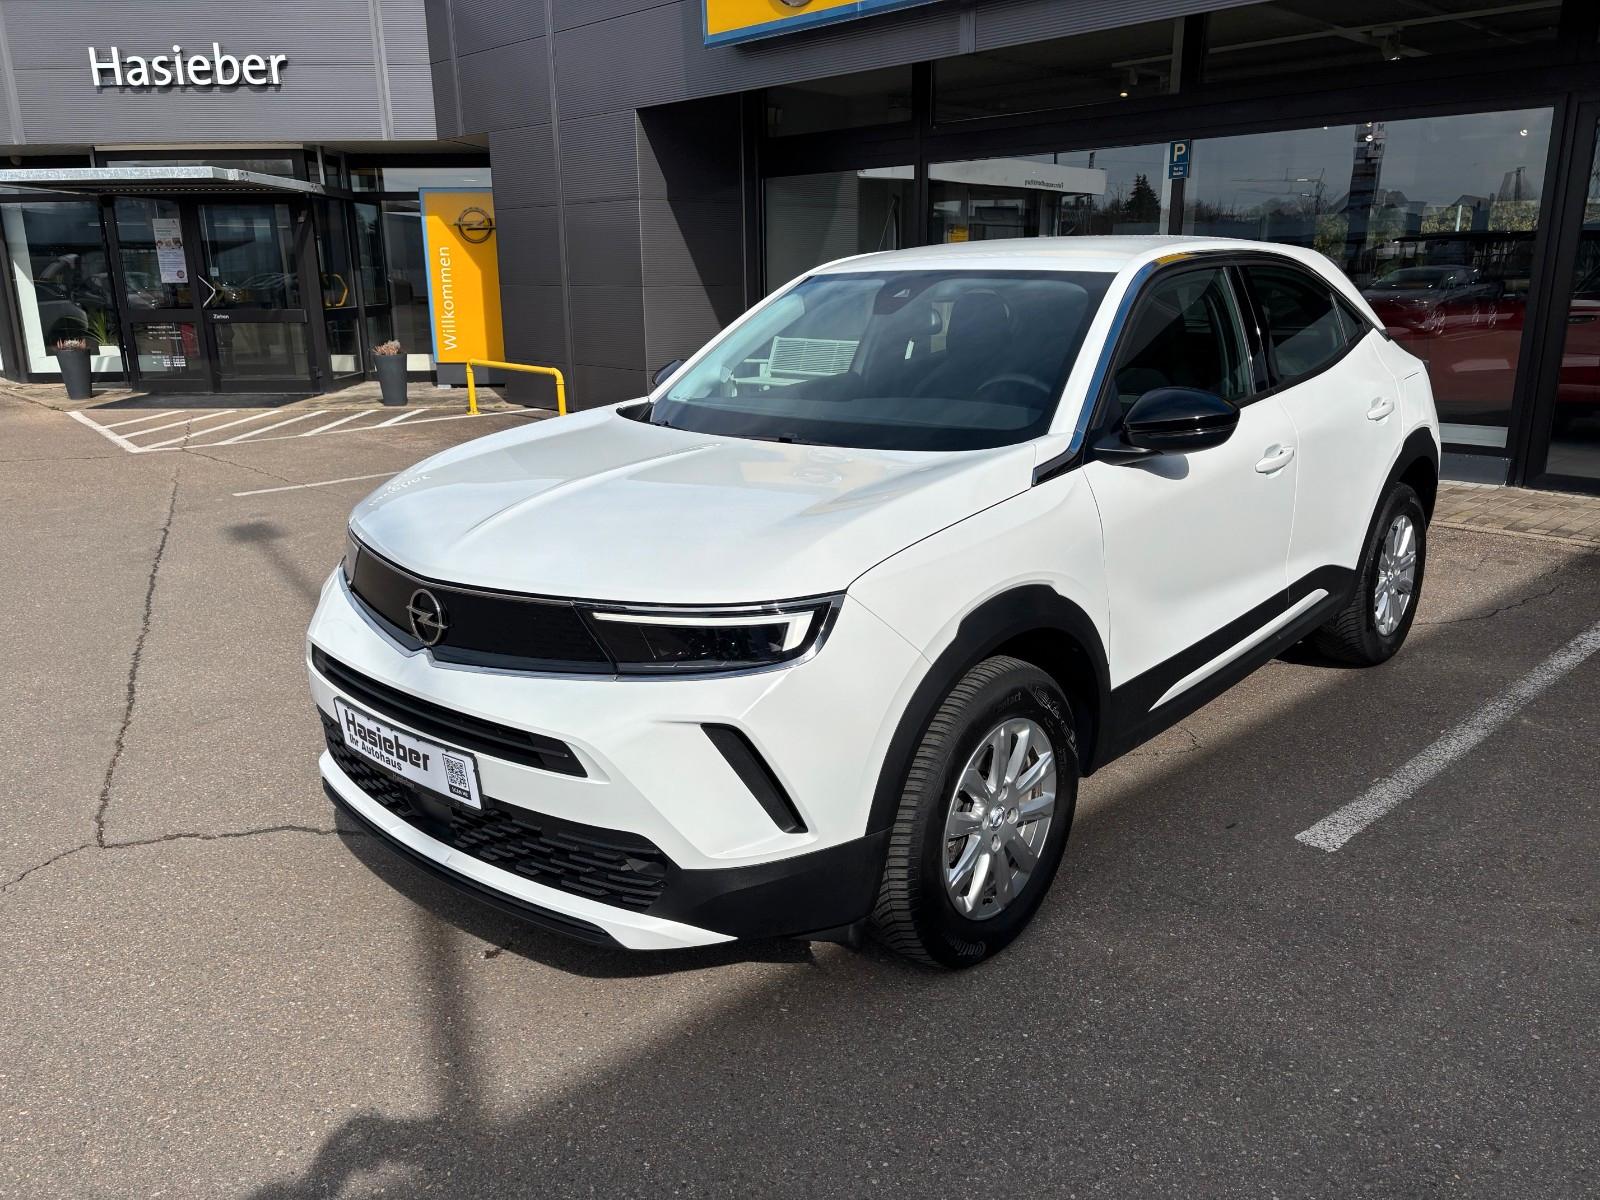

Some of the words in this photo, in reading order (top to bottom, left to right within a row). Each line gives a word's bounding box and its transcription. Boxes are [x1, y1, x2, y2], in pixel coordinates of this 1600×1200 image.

[88, 42, 286, 86] Hasieber
[1174, 143, 1186, 162] P
[439, 246, 458, 351] Willkommen
[344, 708, 430, 772] Hasieber
[361, 740, 403, 771] Autohaus
